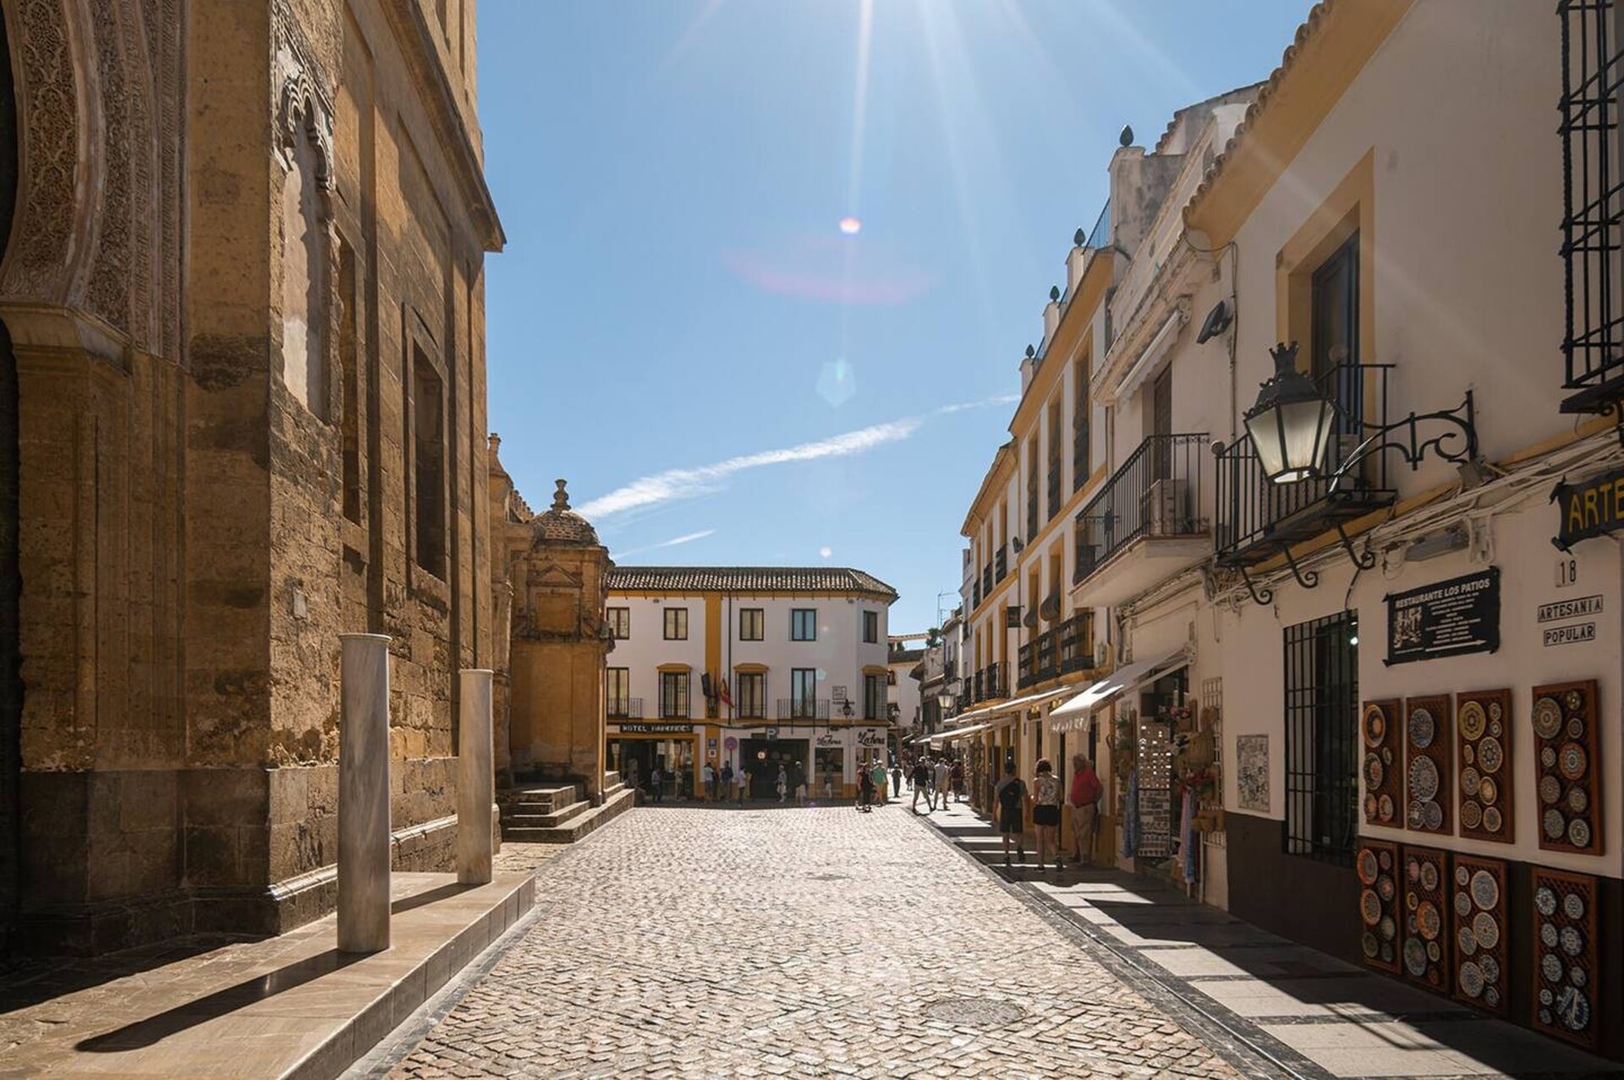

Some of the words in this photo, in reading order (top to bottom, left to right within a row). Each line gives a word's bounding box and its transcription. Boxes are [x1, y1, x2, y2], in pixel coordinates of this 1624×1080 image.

[1569, 478, 1624, 533] ARTE
[1560, 560, 1576, 584] 18
[1395, 590, 1443, 608] RESTAURANTE
[1444, 585, 1459, 597] LOS
[1461, 578, 1490, 593] PATIOS
[1540, 598, 1600, 619] ARTESANIA
[1546, 625, 1594, 643] POPULAR
[766, 728, 777, 740] P
